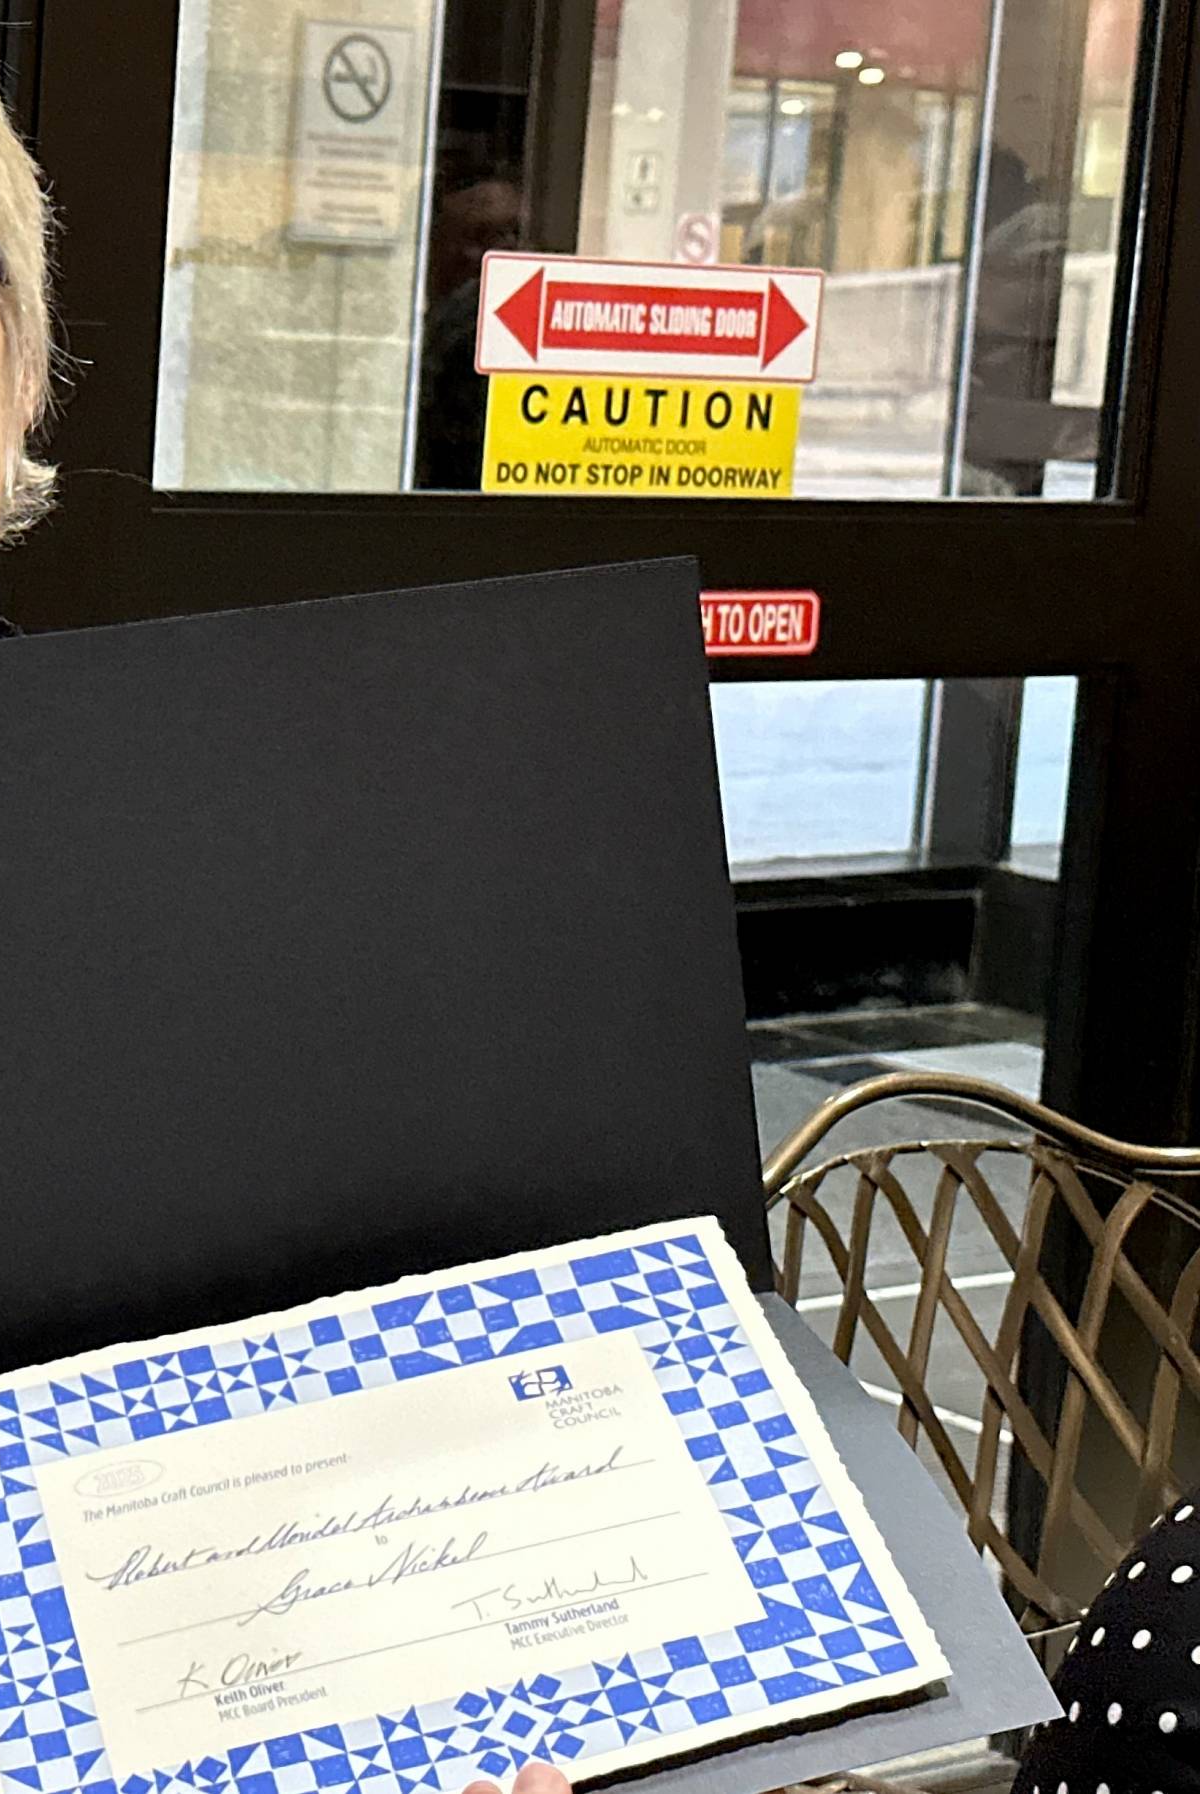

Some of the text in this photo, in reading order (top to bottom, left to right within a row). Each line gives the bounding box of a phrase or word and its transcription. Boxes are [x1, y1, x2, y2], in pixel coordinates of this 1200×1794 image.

[550, 299, 758, 338] AUTOMATIC SLIDING DOOR
[520, 384, 773, 431] CAUTION
[583, 437, 706, 456] AUTOMATIC DOOR
[496, 462, 782, 489] DO NOT STOP IN DOORWAY
[717, 603, 745, 643] TO
[748, 602, 805, 643] OPEN
[545, 1384, 624, 1409] MANITOBA
[549, 1402, 593, 1419] CRAFT
[553, 1407, 621, 1429] COUNCIL
[83, 1508, 104, 1523] The
[106, 1496, 158, 1518] Manitoba
[161, 1487, 187, 1504] Craft
[190, 1478, 230, 1497] Council
[233, 1476, 241, 1488] is
[244, 1465, 288, 1488] pleased
[291, 1463, 302, 1476] to
[374, 1534, 388, 1546] to
[85, 1545, 214, 1590] Robert
[367, 1530, 488, 1588] Nickel
[504, 1598, 620, 1636] Tammy Sutherland
[510, 1613, 629, 1650] MCC Executive Director
[214, 1681, 285, 1707] Keith Oliver
[219, 1686, 328, 1722] MCC Board President
